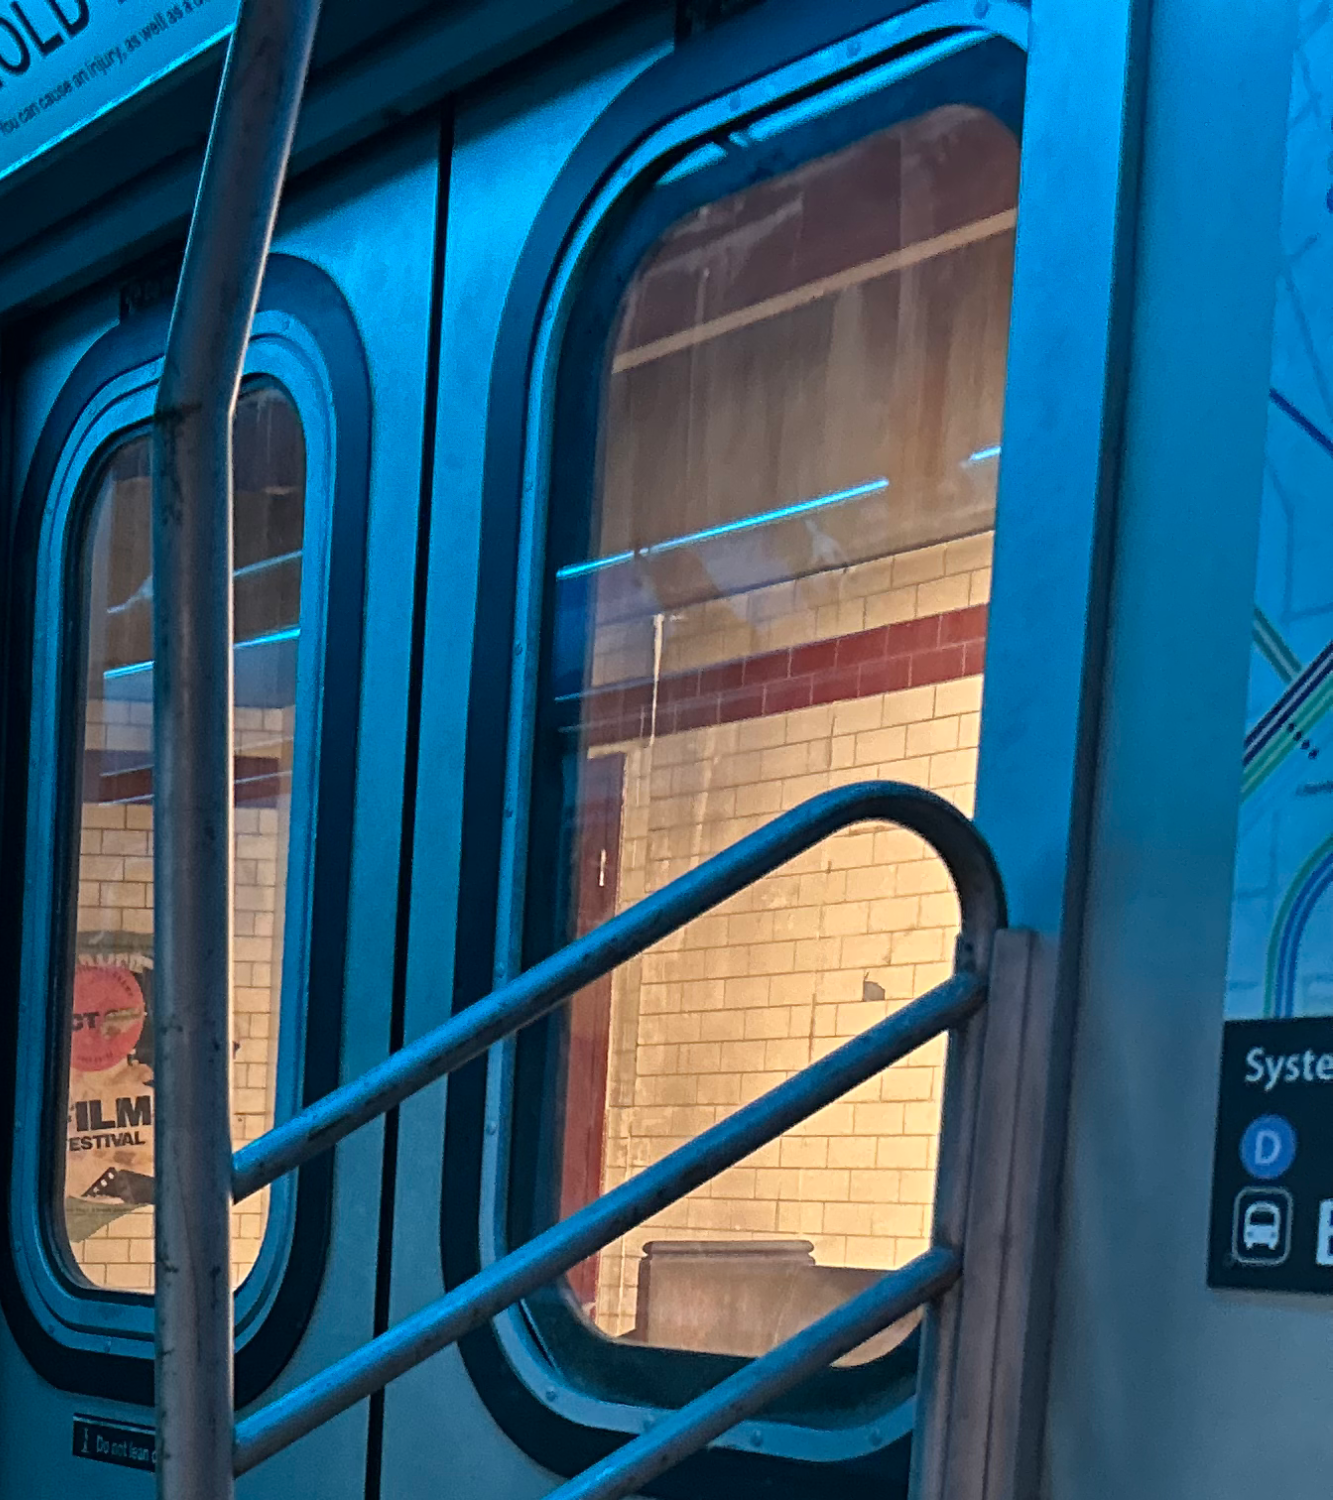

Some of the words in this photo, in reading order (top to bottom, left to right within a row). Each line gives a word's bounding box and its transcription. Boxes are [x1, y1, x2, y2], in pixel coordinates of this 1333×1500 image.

[17, 102, 41, 124] can
[38, 80, 73, 110] cause
[72, 68, 90, 89] an
[85, 44, 127, 79] injury,
[124, 34, 141, 53] as
[139, 10, 169, 42] well
[166, 5, 185, 24] as
[1244, 1047, 1333, 1092] Syste
[68, 1095, 152, 1132] ILM
[68, 1131, 146, 1152] ESTIVAL
[1254, 1134, 1281, 1166] D
[96, 1434, 110, 1455] Do
[111, 1440, 128, 1457] not
[128, 1440, 150, 1461] lean
